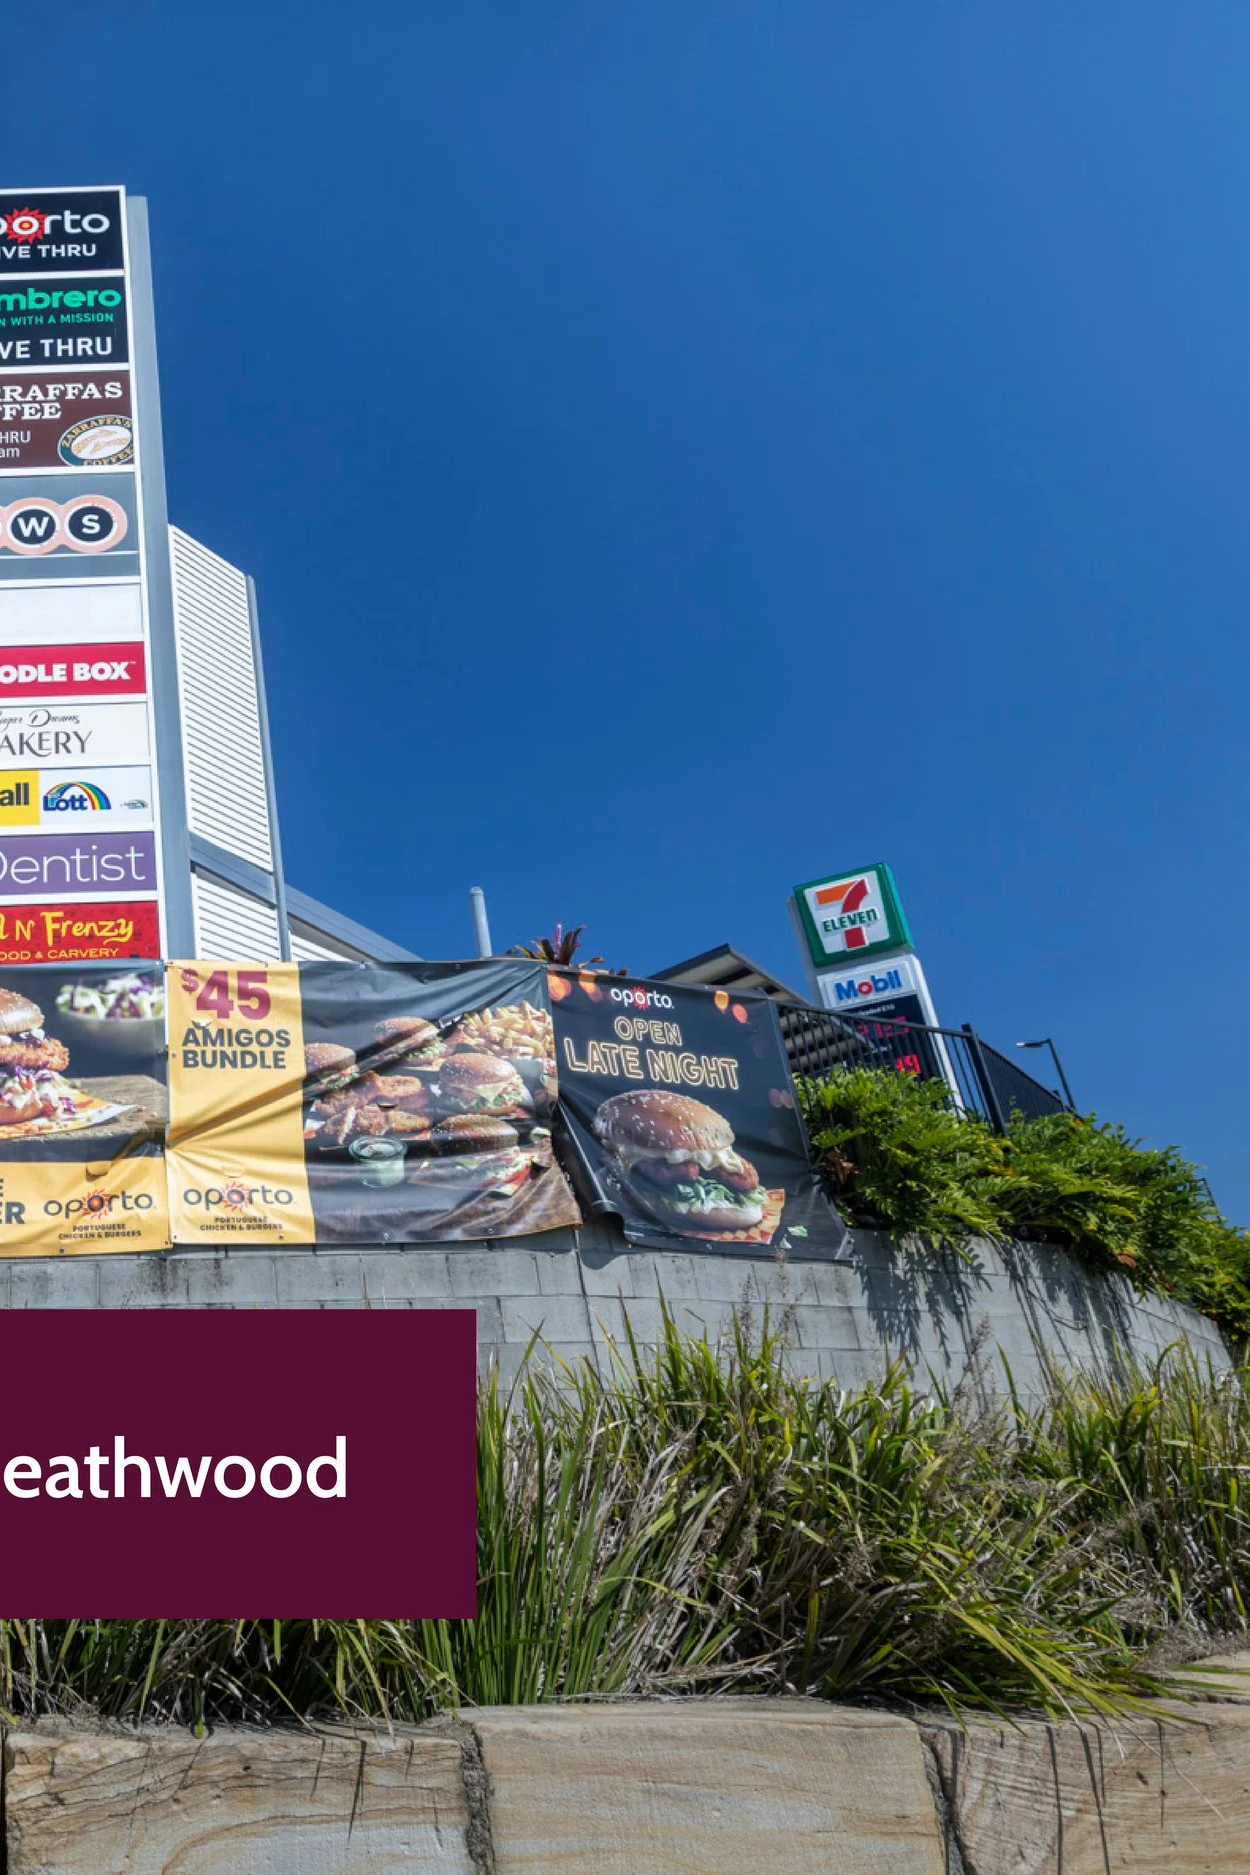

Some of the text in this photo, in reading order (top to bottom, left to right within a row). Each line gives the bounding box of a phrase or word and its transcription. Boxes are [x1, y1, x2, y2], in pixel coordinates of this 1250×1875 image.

[37, 244, 97, 258] THRU
[11, 315, 44, 326] WITH
[47, 314, 57, 324] A
[60, 312, 114, 324] MISSION
[40, 336, 113, 358] THRU
[73, 661, 132, 681] BOX
[815, 878, 869, 950] 7
[40, 911, 134, 946] Frenzy
[35, 950, 43, 960] &
[47, 948, 119, 960] CARVERY
[181, 967, 271, 1020] $45
[834, 969, 903, 1001] Mobil
[610, 987, 673, 1009] oporto
[182, 1028, 291, 1048] AMIGOS
[614, 1016, 683, 1046] OPEN
[182, 1050, 287, 1069] BUNDLE
[563, 1037, 739, 1090] LATE NIGHT
[43, 1190, 154, 1219] oporto
[183, 1185, 294, 1211] oporto
[58, 1232, 95, 1240] CHICKEN
[104, 1230, 142, 1238] BURGERS
[72, 1223, 127, 1232] PORTUGUESE
[199, 1223, 237, 1231] CHICKEN
